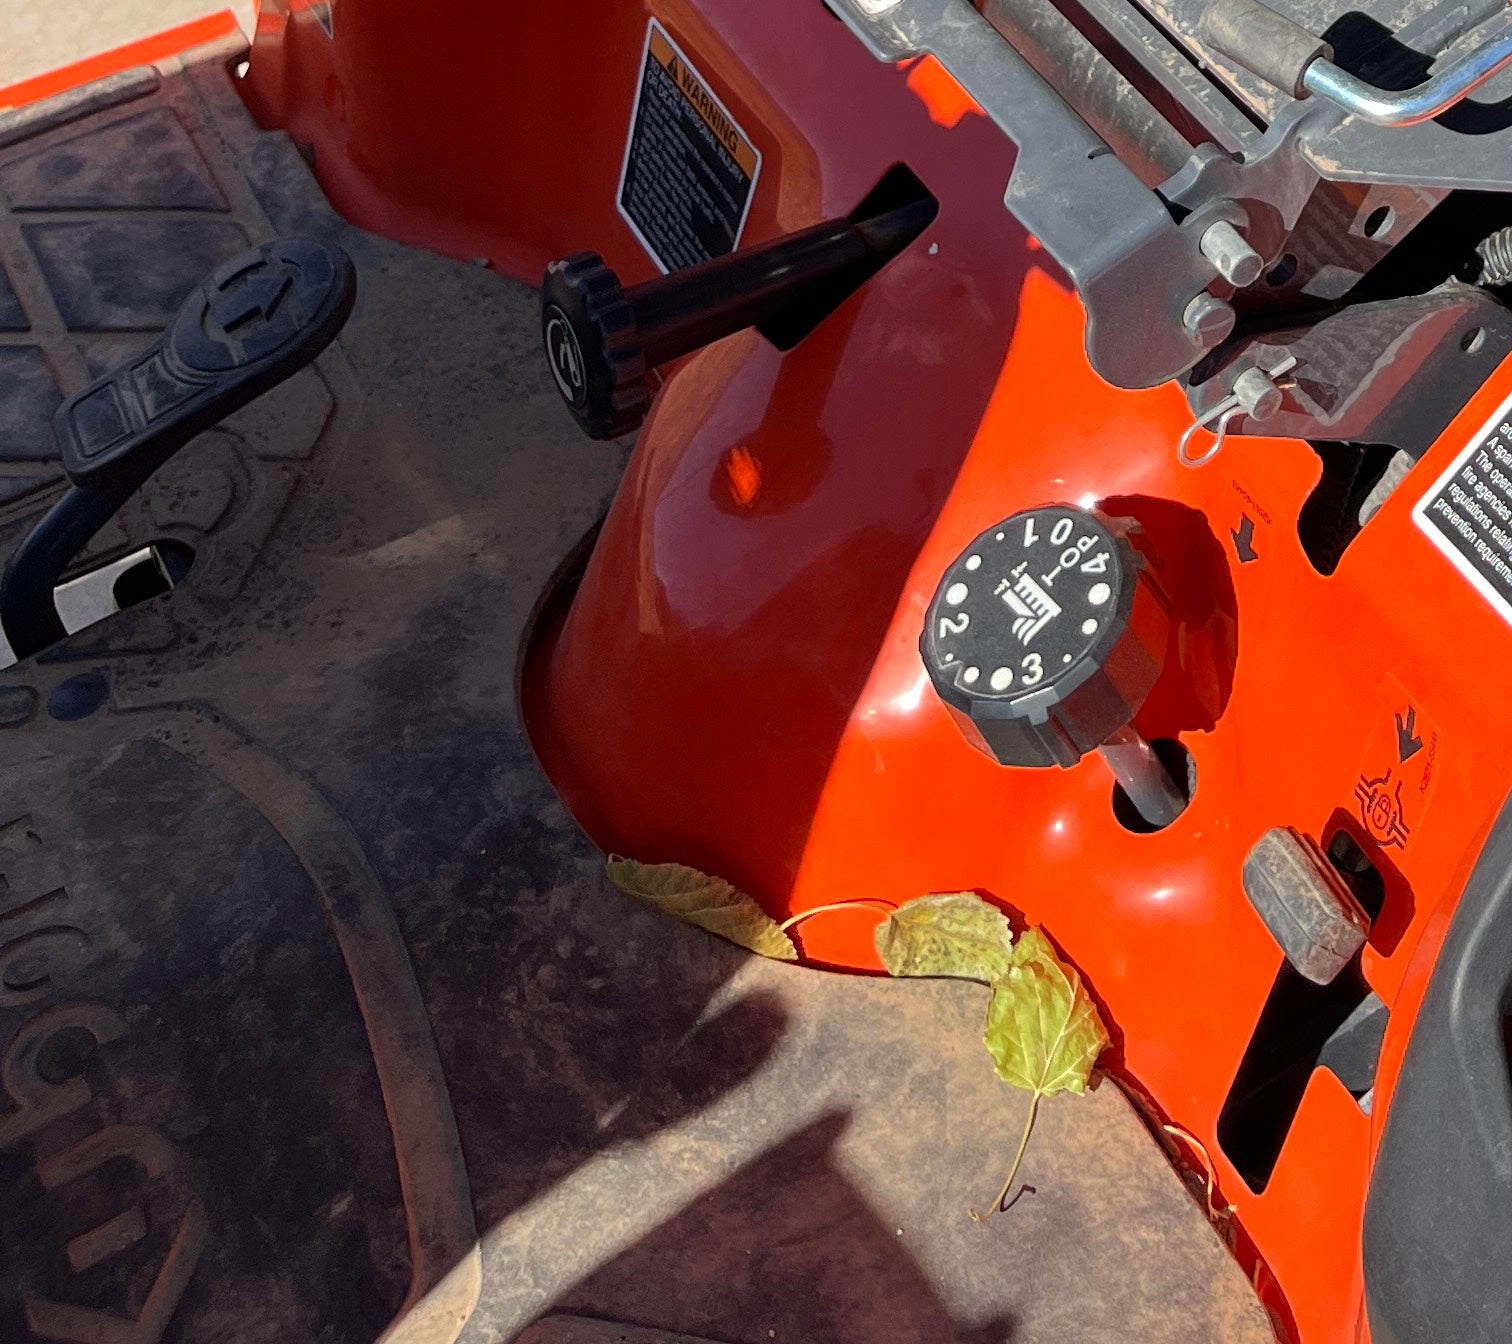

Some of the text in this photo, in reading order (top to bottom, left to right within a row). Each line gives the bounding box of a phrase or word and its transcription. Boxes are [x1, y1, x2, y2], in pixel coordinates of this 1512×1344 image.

[680, 66, 739, 154] WARNING
[1486, 436, 1499, 450] A
[1475, 449, 1494, 473] The
[1447, 482, 1493, 530] regulations
[1461, 465, 1478, 485] fire
[1473, 481, 1512, 521] agencies
[1024, 518, 1040, 547] 1
[1432, 497, 1478, 544] prevention
[1080, 552, 1110, 573] 4
[939, 612, 970, 639] 2
[1021, 652, 1044, 685] 3
